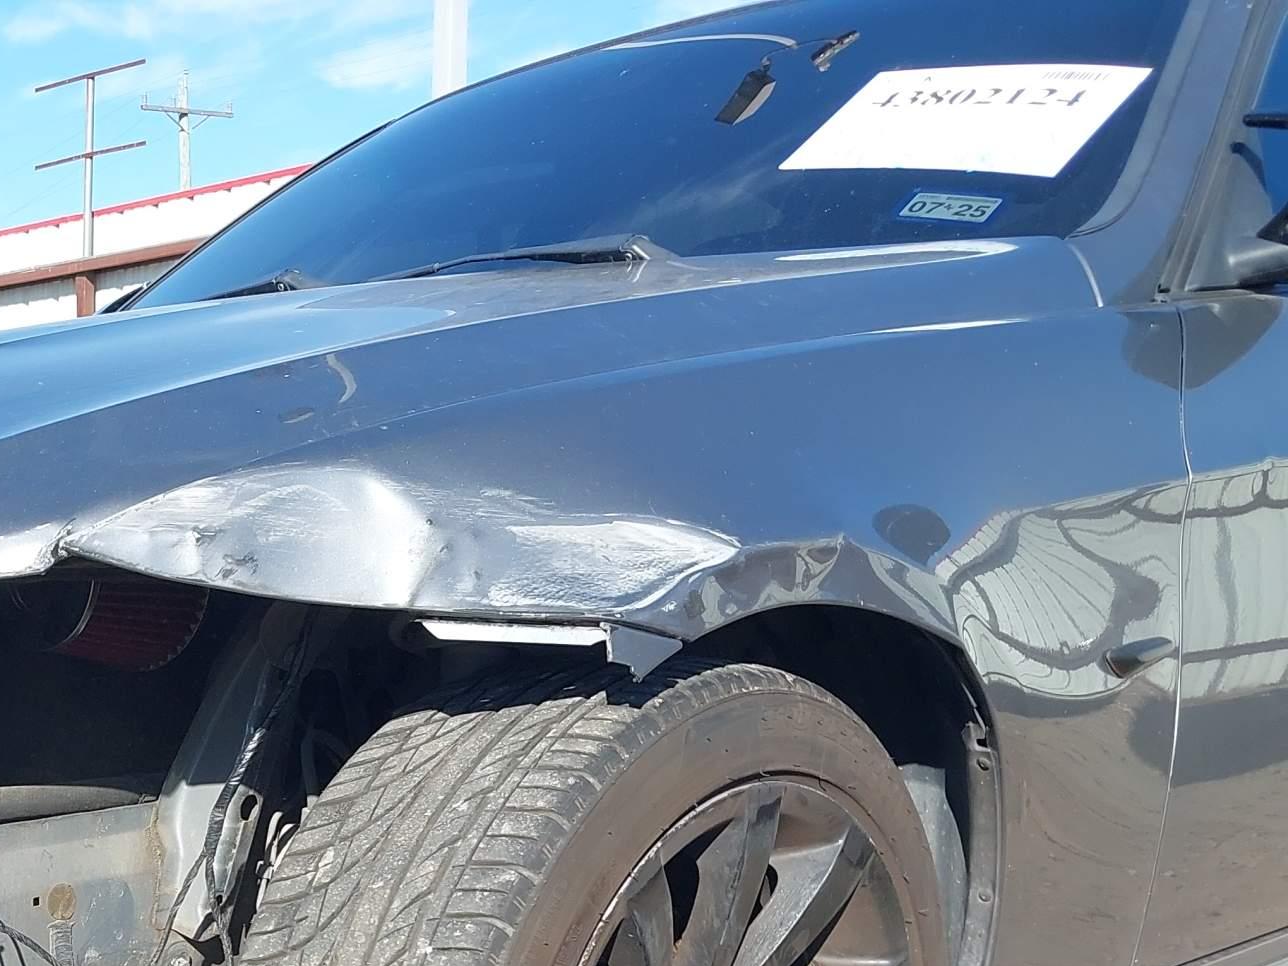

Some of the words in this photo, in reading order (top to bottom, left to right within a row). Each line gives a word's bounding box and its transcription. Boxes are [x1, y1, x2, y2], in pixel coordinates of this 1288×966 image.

[872, 87, 1089, 109] 43802124
[907, 200, 946, 215] 07
[951, 203, 991, 218] 25
